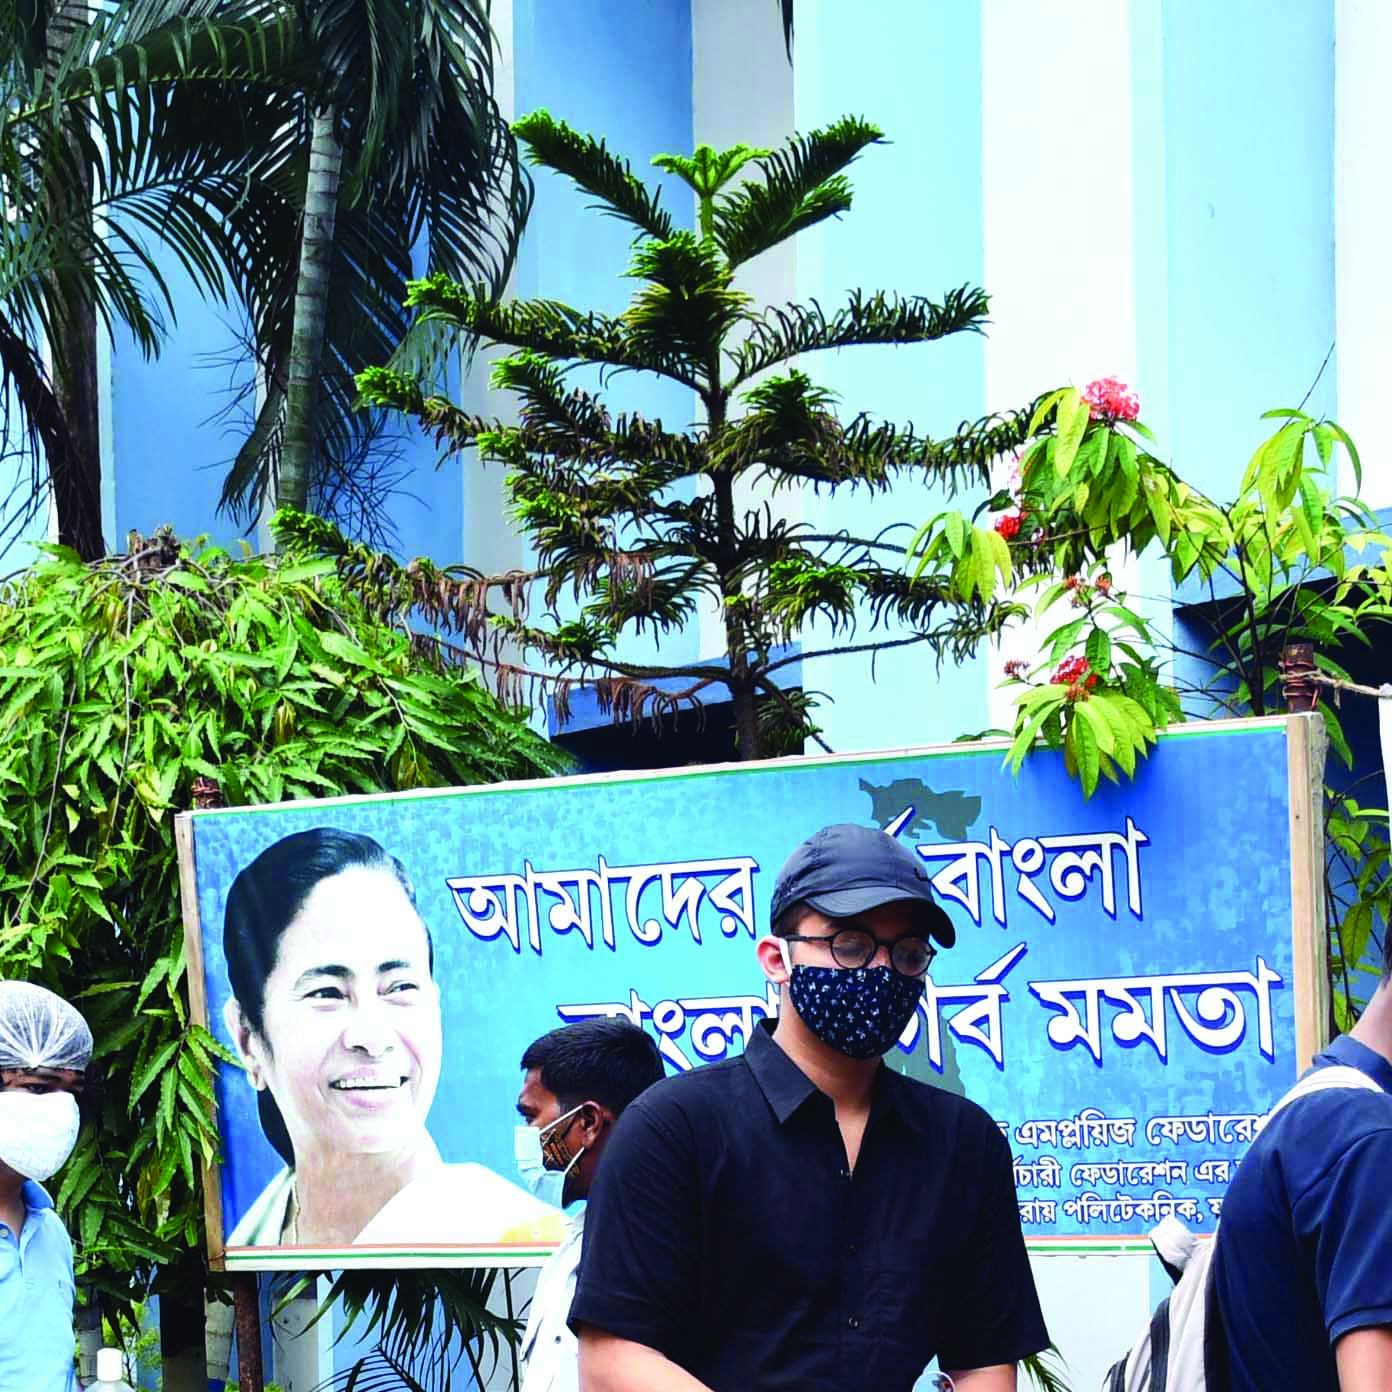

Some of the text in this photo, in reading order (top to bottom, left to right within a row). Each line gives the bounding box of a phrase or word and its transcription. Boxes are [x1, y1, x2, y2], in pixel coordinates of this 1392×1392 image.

[446, 817, 1152, 956] আমাদের বাংলা
[1028, 955, 1285, 1066] মমতা
[1015, 1108, 1137, 1149] এমপ্লয়িজ
[1070, 1160, 1188, 1187] ফেডারেশন
[1194, 1160, 1231, 1184] এর
